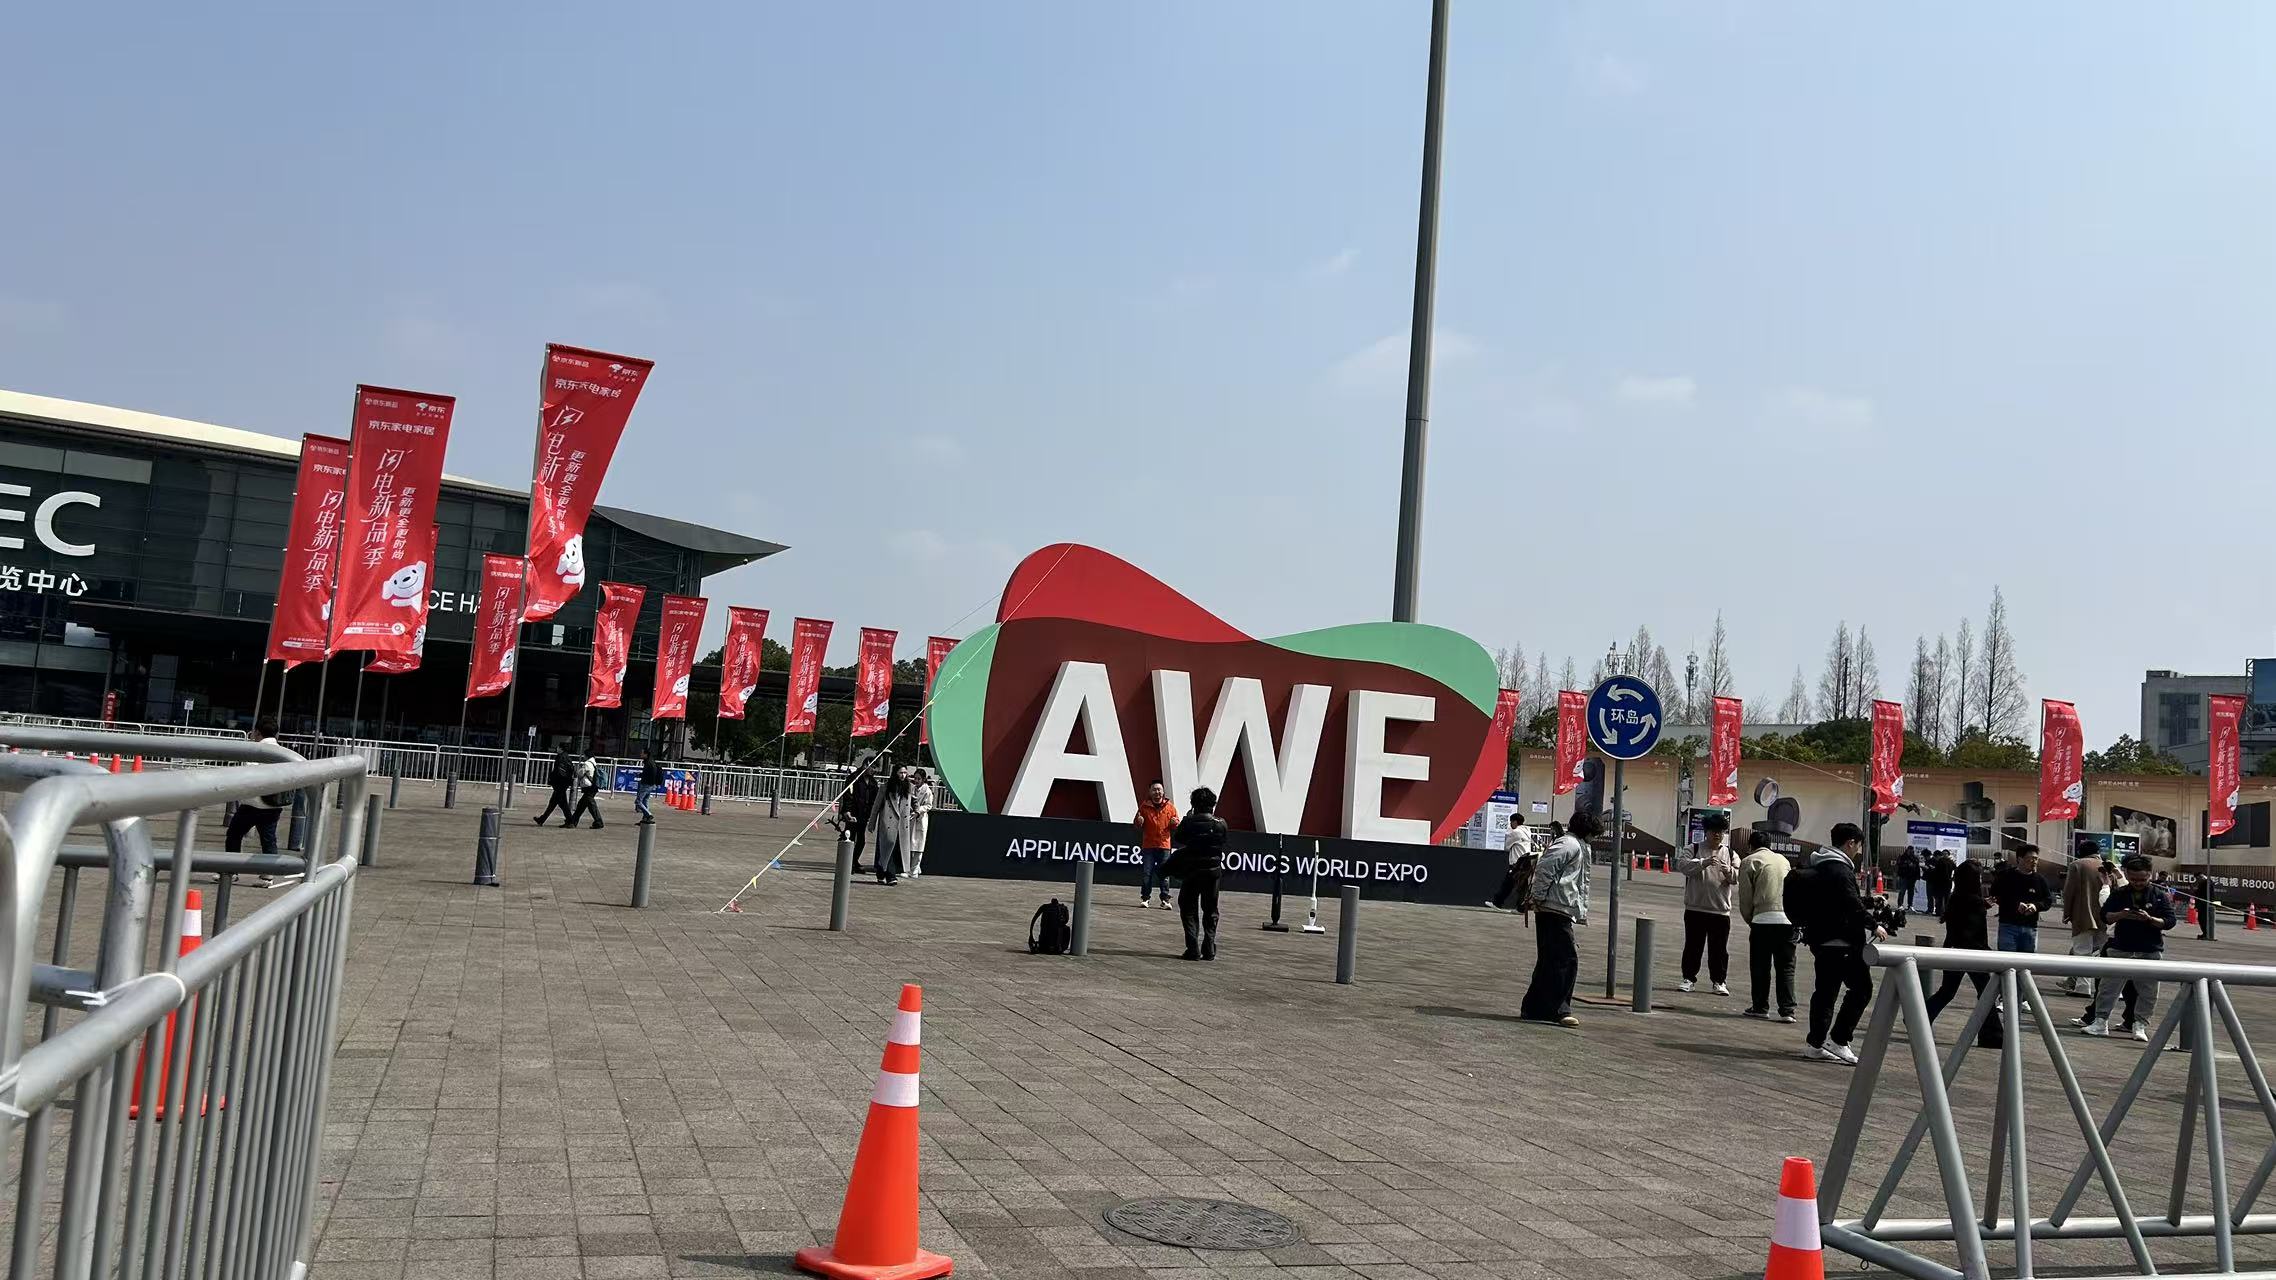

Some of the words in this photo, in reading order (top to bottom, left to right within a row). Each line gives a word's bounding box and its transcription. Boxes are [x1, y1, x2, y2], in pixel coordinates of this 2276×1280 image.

[368, 420, 435, 436] 京东家电家居
[360, 448, 413, 570] 闪电新品季
[391, 486, 417, 560] 更新更全更时尚
[302, 489, 345, 593] 闪电新品季
[0, 565, 88, 597] 览中心
[1610, 708, 1639, 724] 环岛
[1001, 660, 1436, 845] AWE
[1006, 838, 1144, 865] APPLIANCE&
[1296, 856, 1369, 879] WORLD
[1374, 862, 1428, 883] EXPO
[2177, 874, 2197, 884] LED
[2241, 879, 2276, 890] R8000
